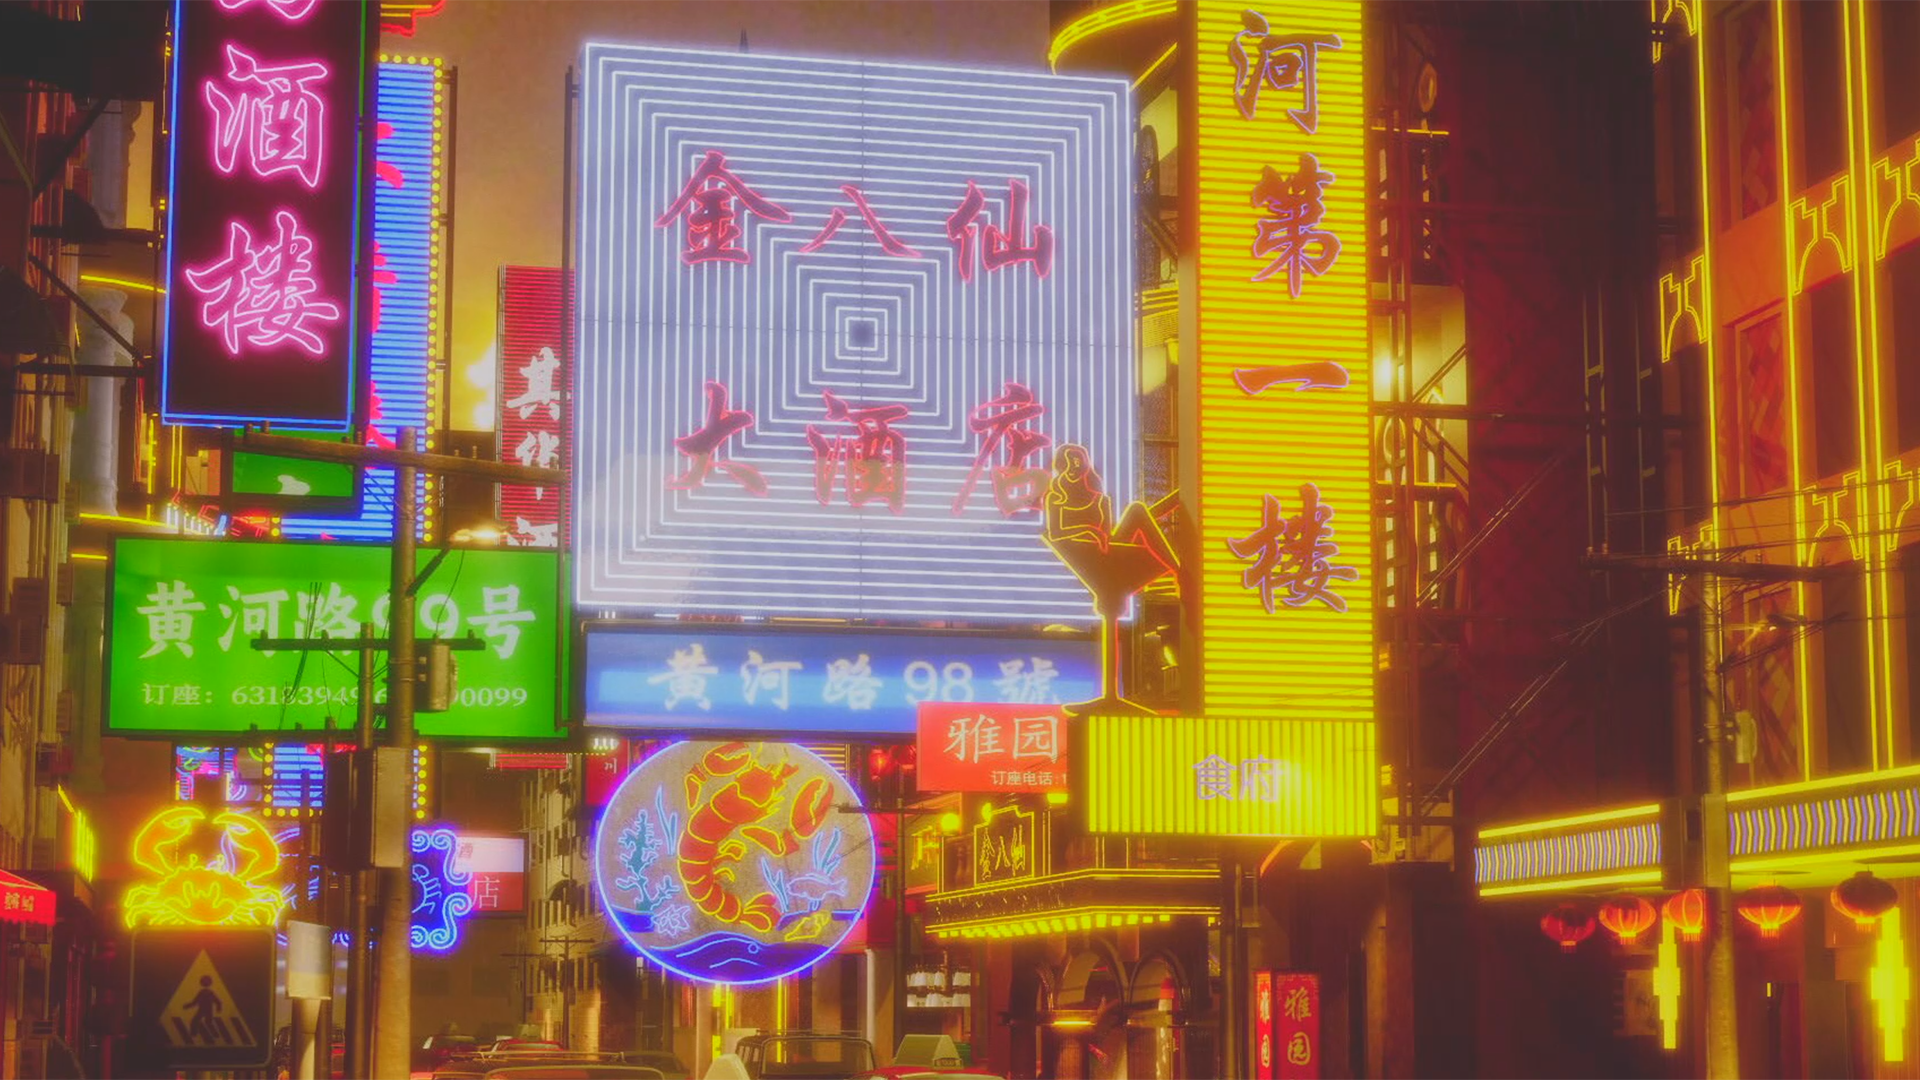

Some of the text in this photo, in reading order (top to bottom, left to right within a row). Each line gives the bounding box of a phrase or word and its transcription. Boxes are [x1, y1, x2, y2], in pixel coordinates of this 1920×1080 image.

[184, 0, 340, 355] 酒楼
[654, 150, 1054, 284] 金八仙
[666, 380, 1053, 517] 大酒店
[943, 713, 1059, 764] 雅园
[1191, 753, 1284, 803] 食府
